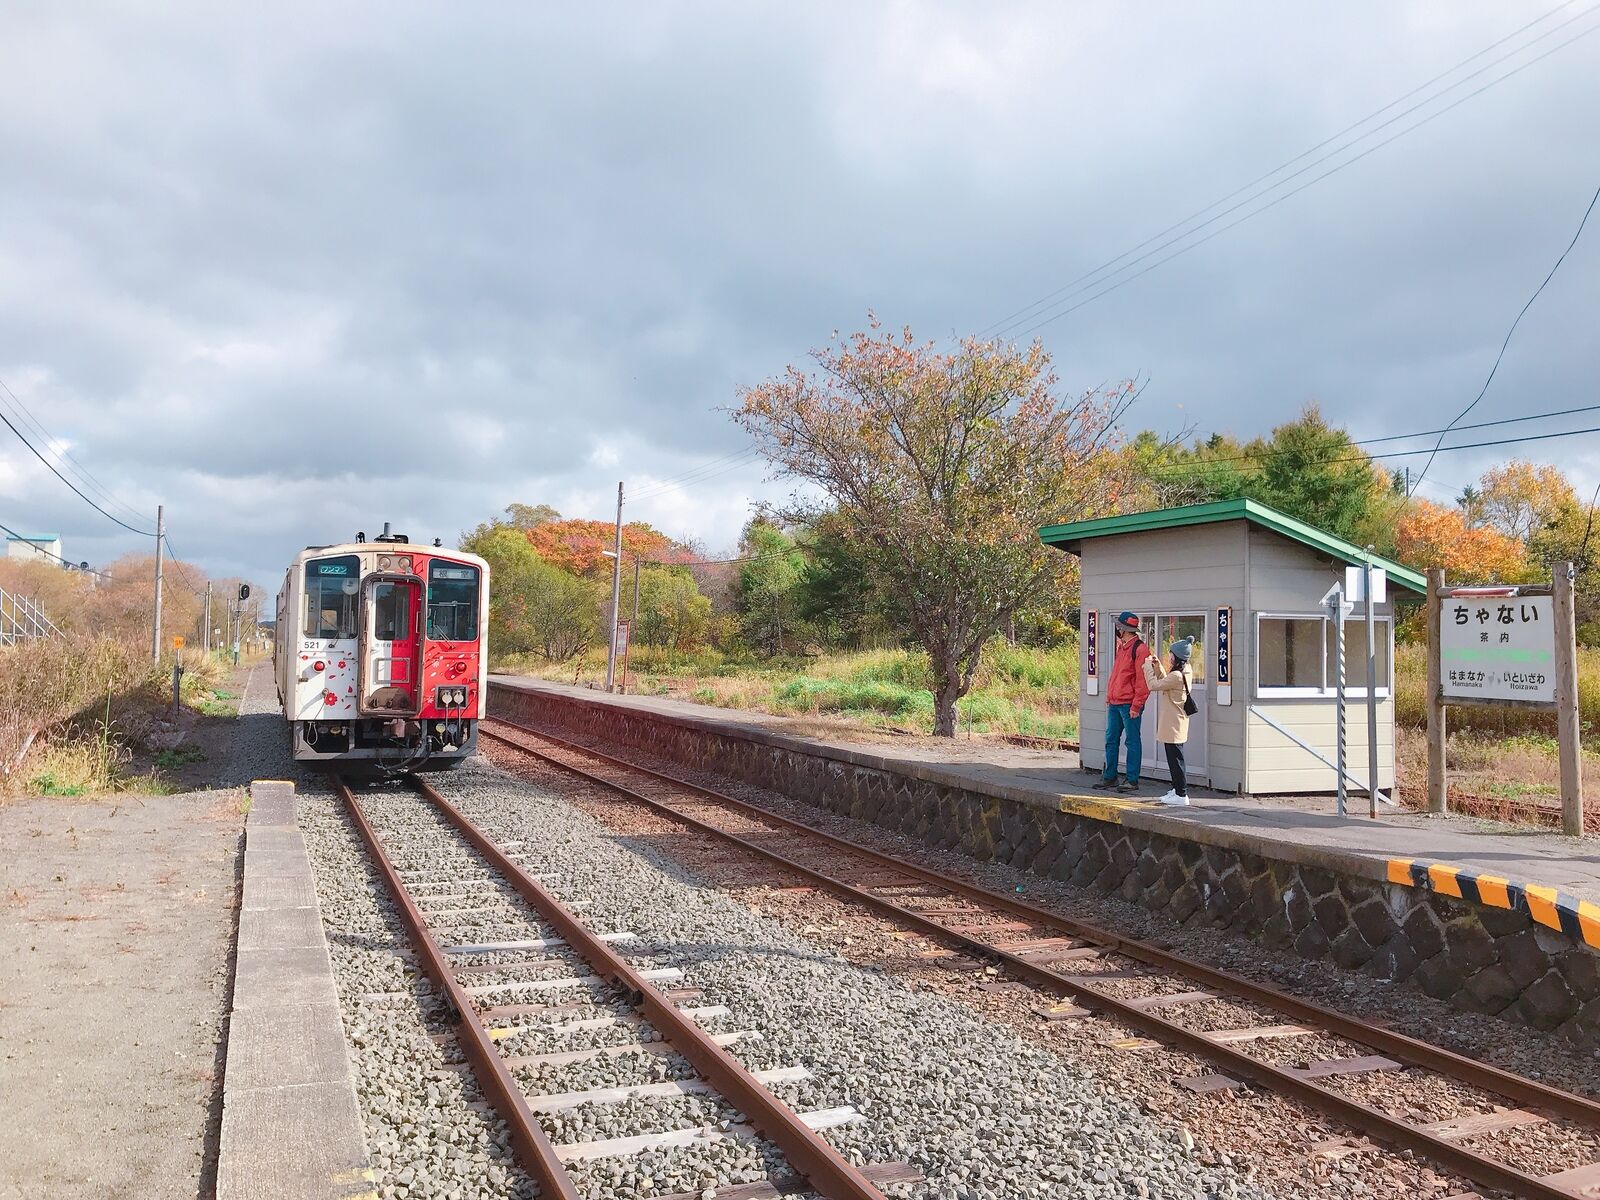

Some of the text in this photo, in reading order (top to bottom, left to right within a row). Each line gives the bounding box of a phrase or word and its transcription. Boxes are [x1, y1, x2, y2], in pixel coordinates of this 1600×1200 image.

[1454, 604, 1539, 625] ちゃない
[1088, 615, 1096, 671] ちゃない
[1480, 632, 1509, 643] 茶内
[304, 641, 319, 649] 521
[1219, 613, 1228, 678] ちゃない
[1449, 670, 1485, 681] はまなか
[1503, 672, 1545, 684] いといざわ
